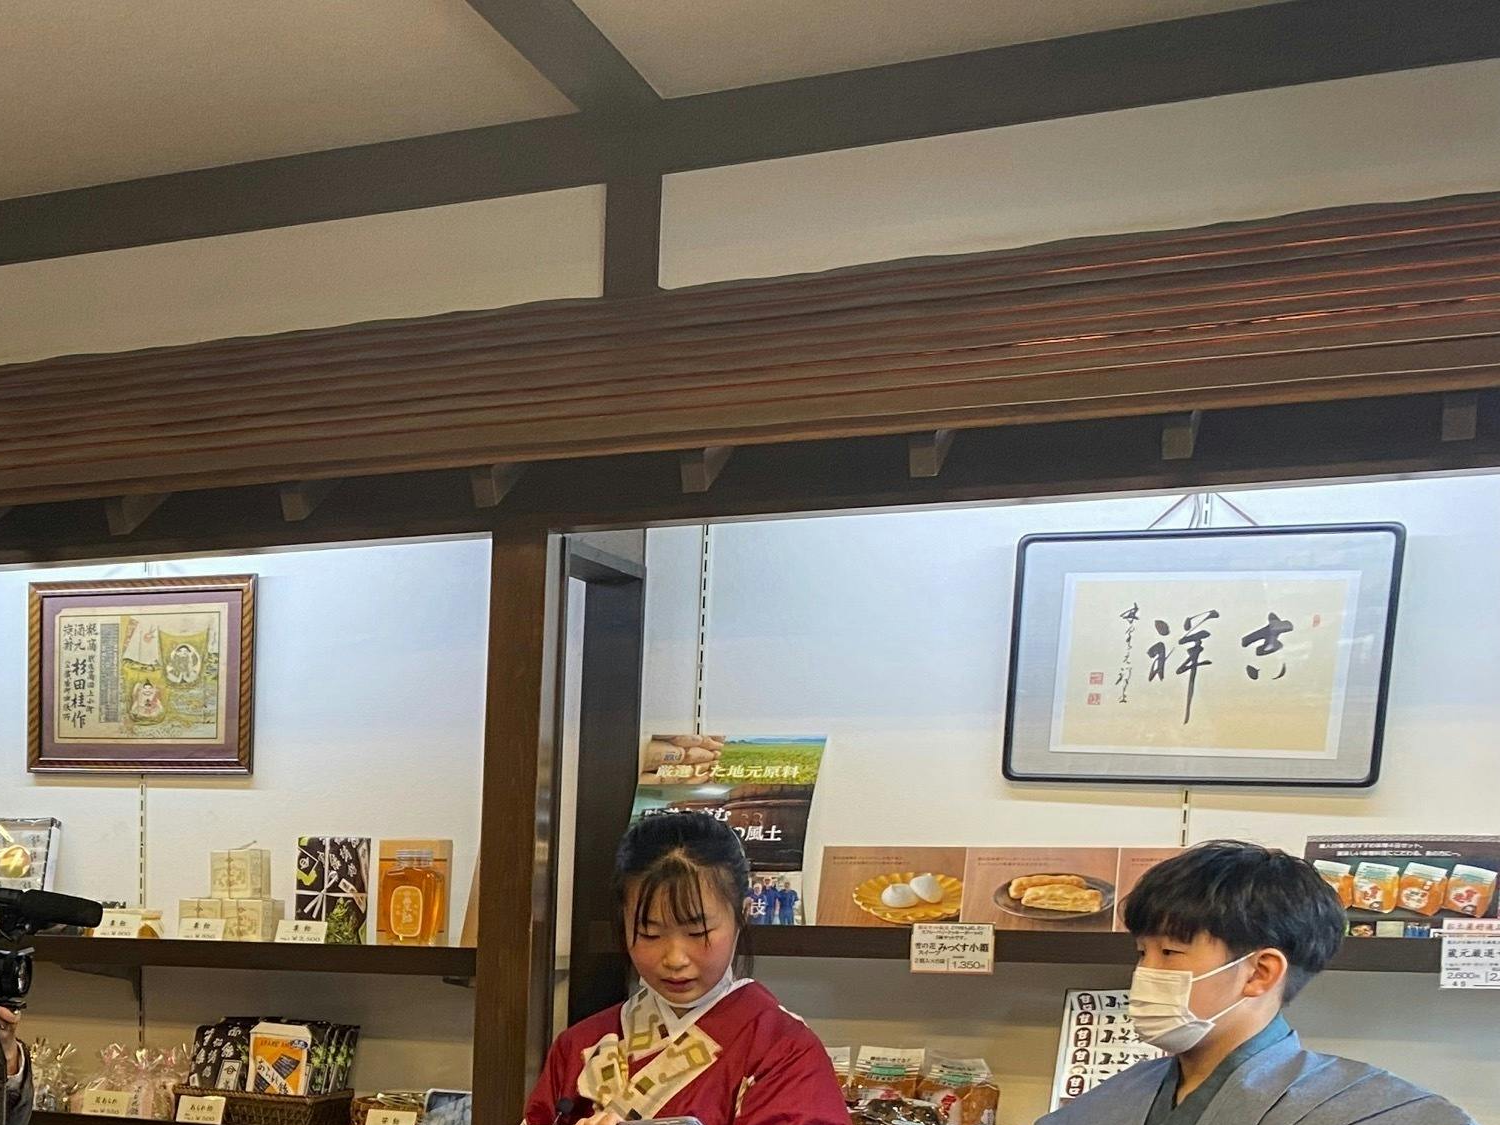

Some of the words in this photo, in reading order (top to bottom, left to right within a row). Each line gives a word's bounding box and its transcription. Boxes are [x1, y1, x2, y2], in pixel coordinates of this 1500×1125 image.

[1147, 609, 1294, 725] 吉祥
[656, 764, 801, 779] 厳選した地元原料
